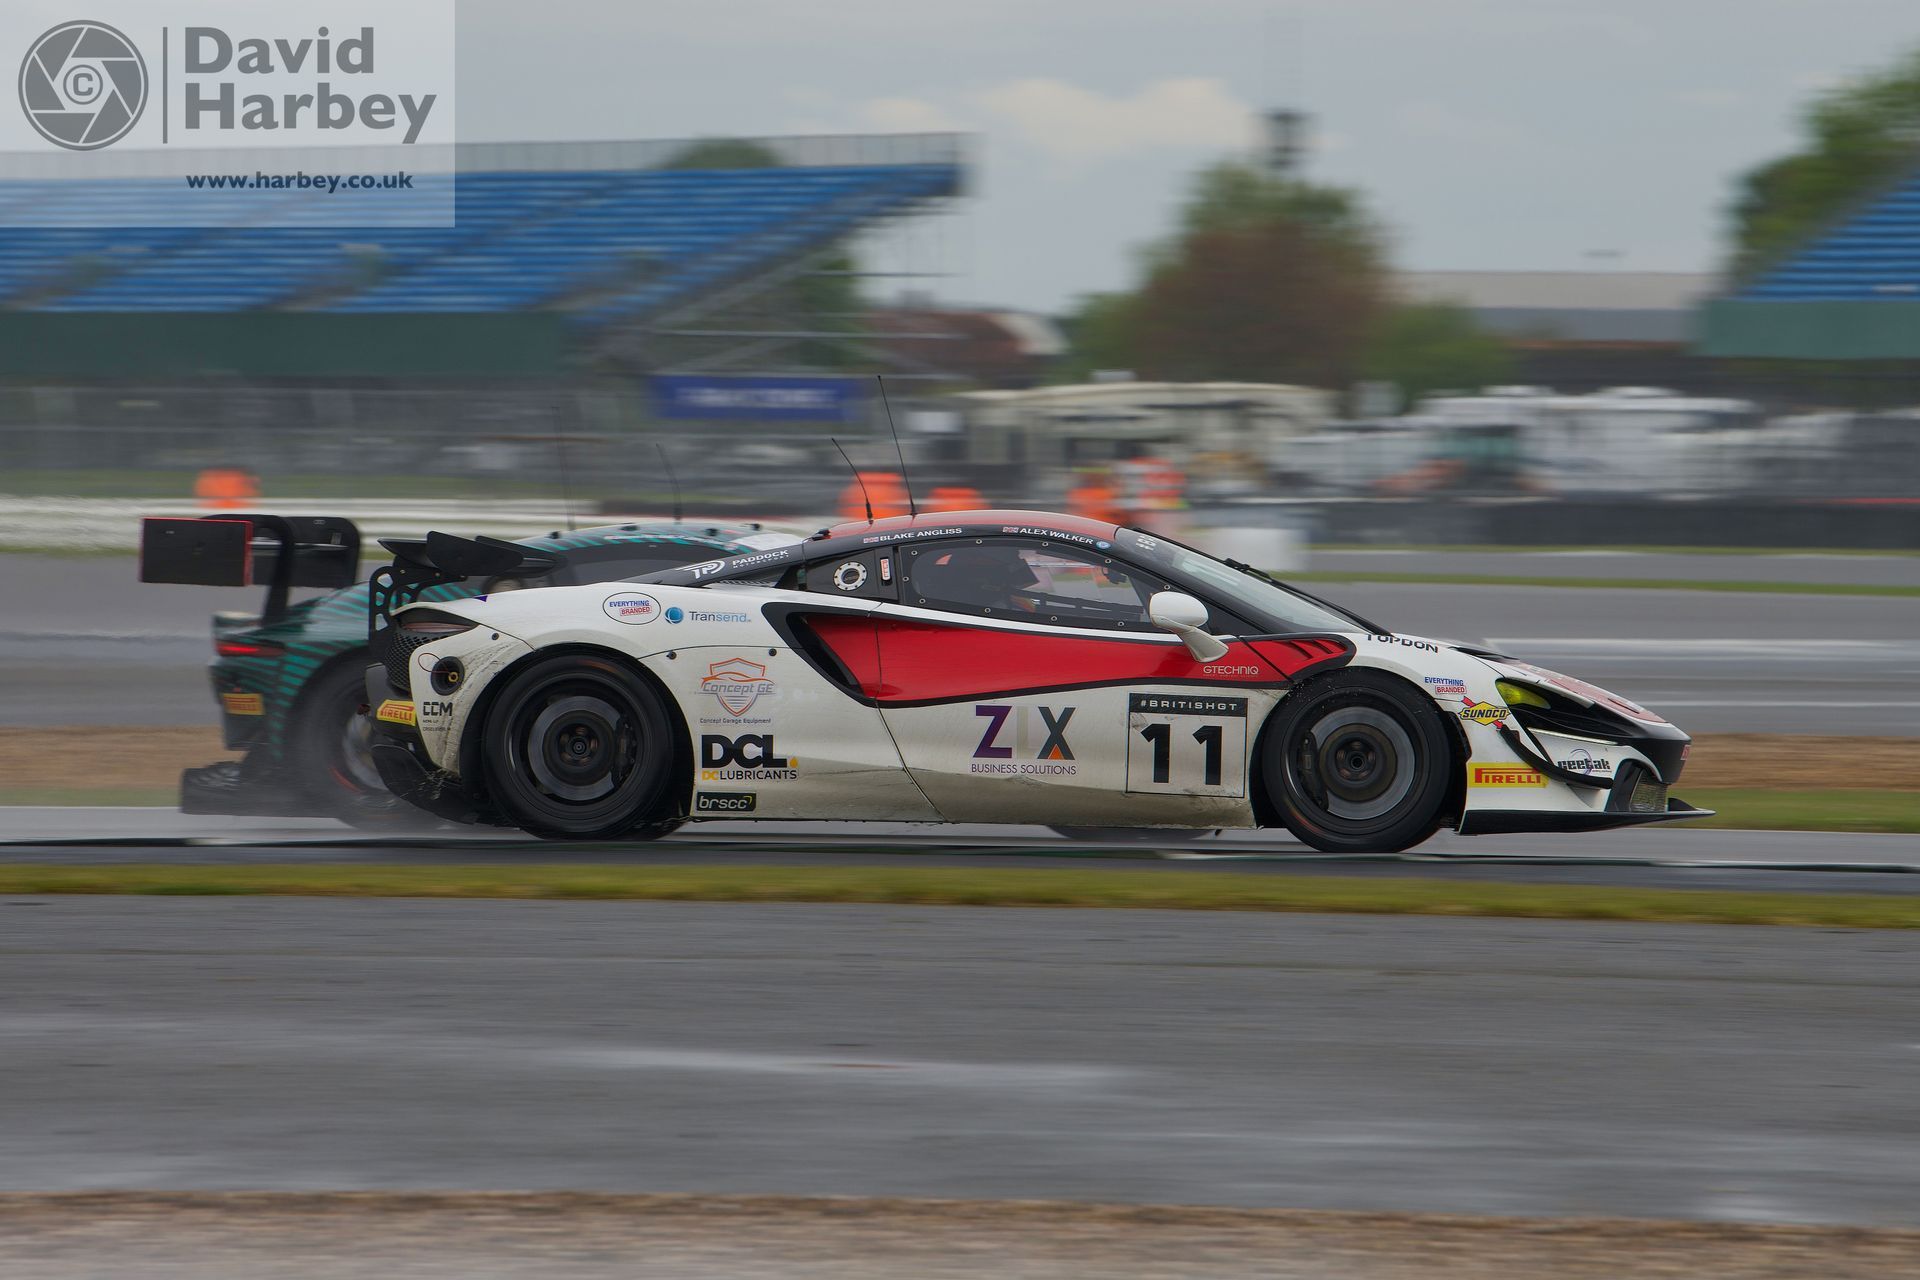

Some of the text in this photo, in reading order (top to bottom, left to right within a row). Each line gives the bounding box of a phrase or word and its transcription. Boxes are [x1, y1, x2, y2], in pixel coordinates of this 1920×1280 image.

[880, 527, 962, 541] BLAKE ANGLISS
[1019, 527, 1094, 545] ALEX WALKER
[732, 550, 789, 565] PADDOCK
[609, 599, 650, 608] EVERYTHING
[621, 606, 651, 615] BRANDED
[689, 611, 747, 623] Transend
[1424, 676, 1464, 687] EVERYTHING
[702, 682, 774, 695] Concept GE
[1140, 699, 1238, 711] #BRITISHGT
[380, 703, 414, 721] PIRELLI
[1463, 709, 1507, 718] SUNOCO
[701, 734, 788, 769] DCL
[1141, 723, 1223, 786] 11
[971, 763, 1077, 775] BUSINESS SOLUTIONS
[1475, 768, 1541, 783] PIRELLI
[699, 796, 748, 809] brscc
